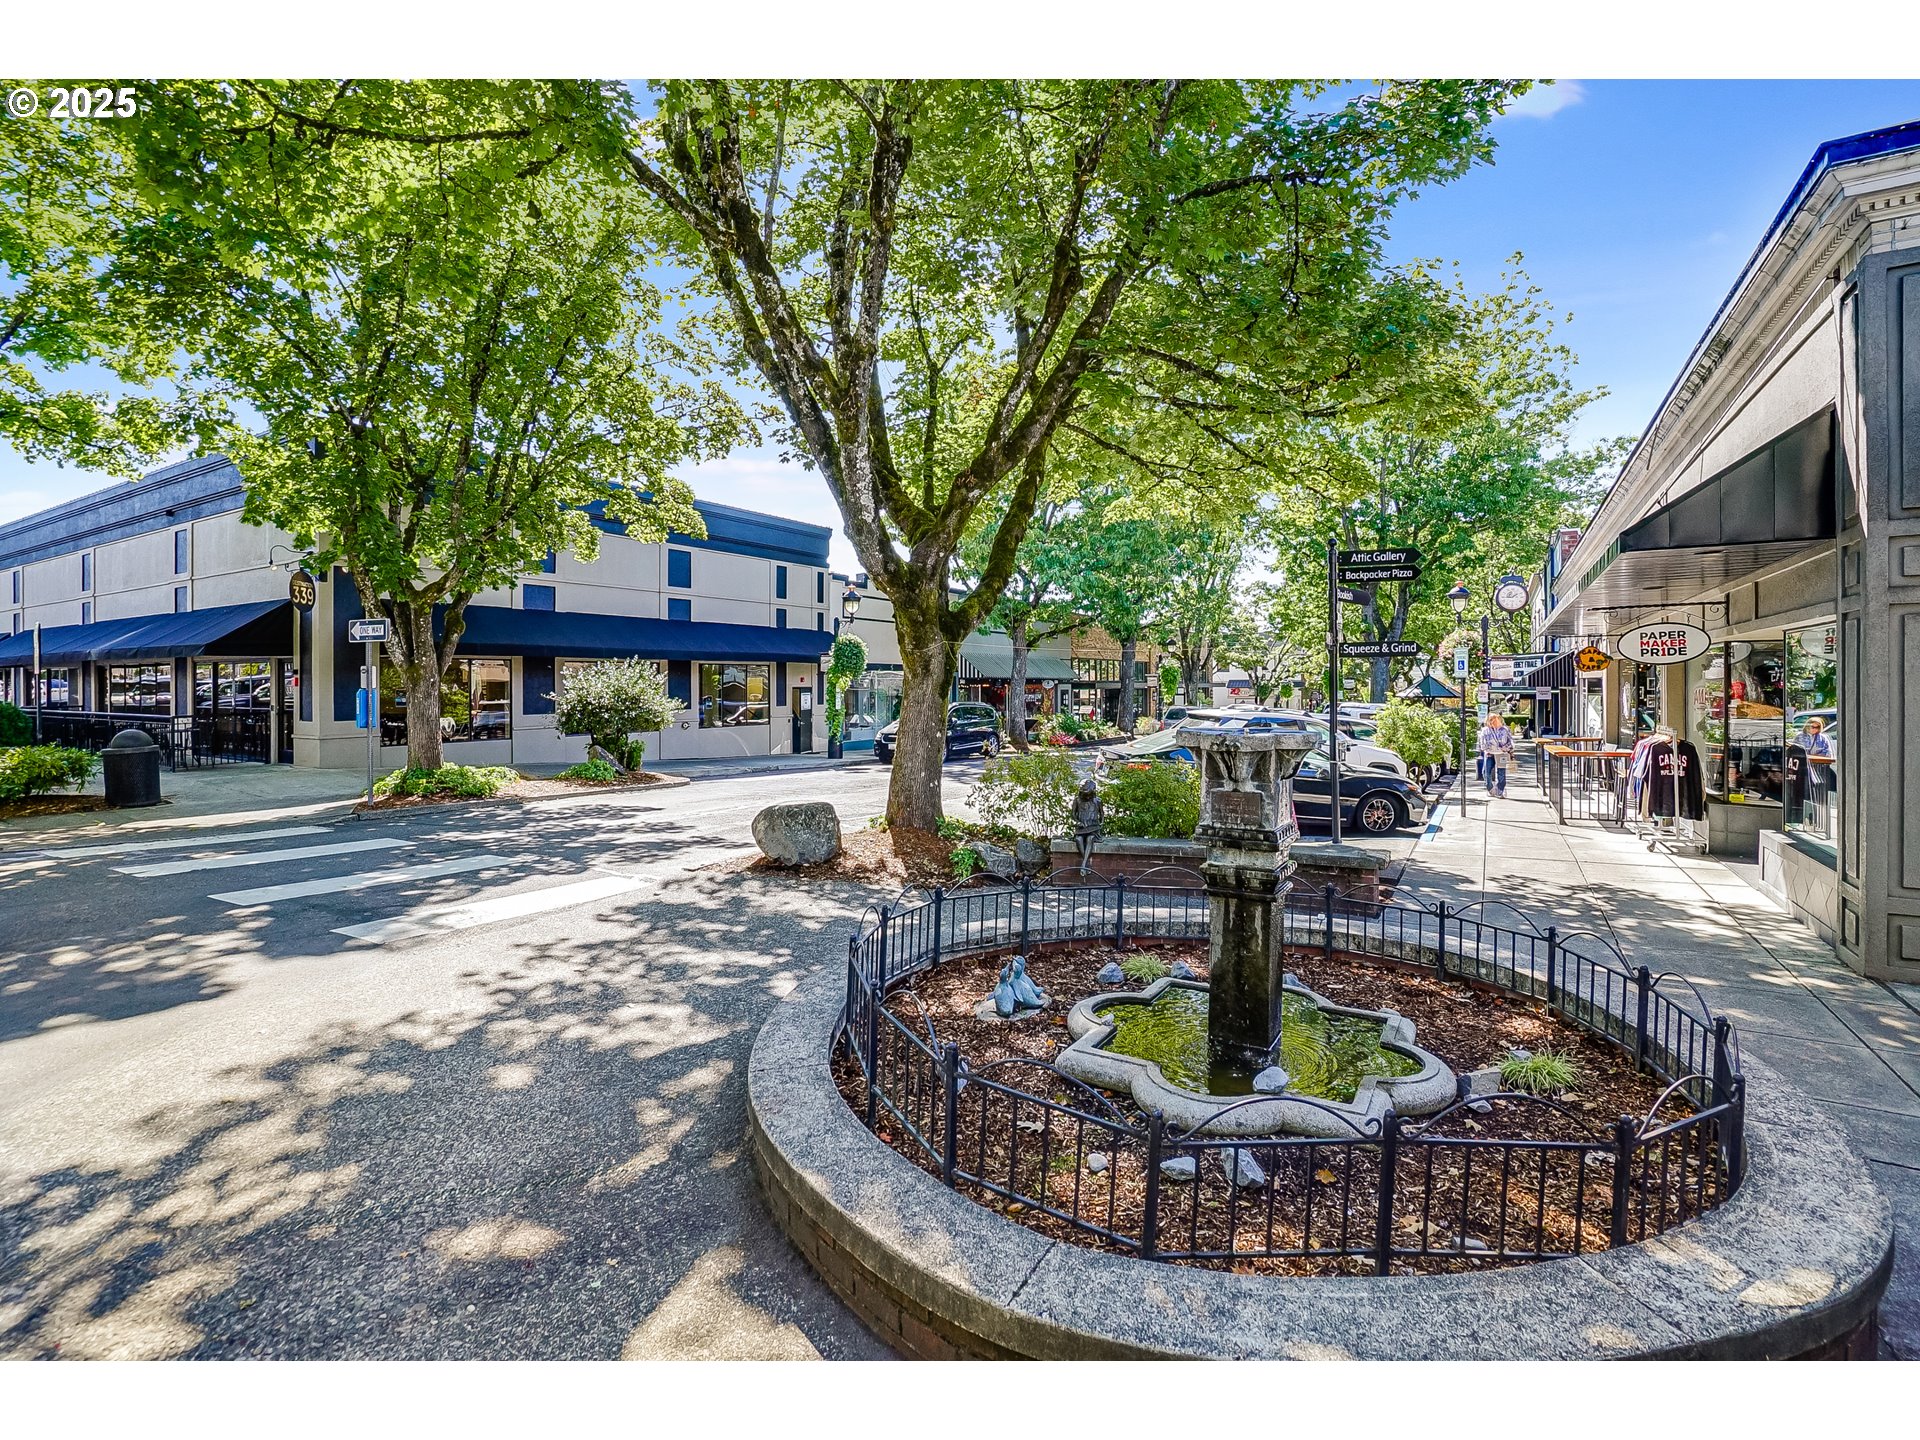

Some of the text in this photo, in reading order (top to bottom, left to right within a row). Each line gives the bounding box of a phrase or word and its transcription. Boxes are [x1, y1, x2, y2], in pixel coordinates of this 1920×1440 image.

[1350, 551, 1406, 563] Attic Gallery
[1345, 568, 1413, 581] Backpacker Pizza
[292, 586, 314, 606] 339
[359, 625, 383, 635] ONE WAY
[1640, 630, 1687, 640] PAPER
[1343, 642, 1417, 656] Squeeze & Grind
[1640, 638, 1687, 648] MAKER
